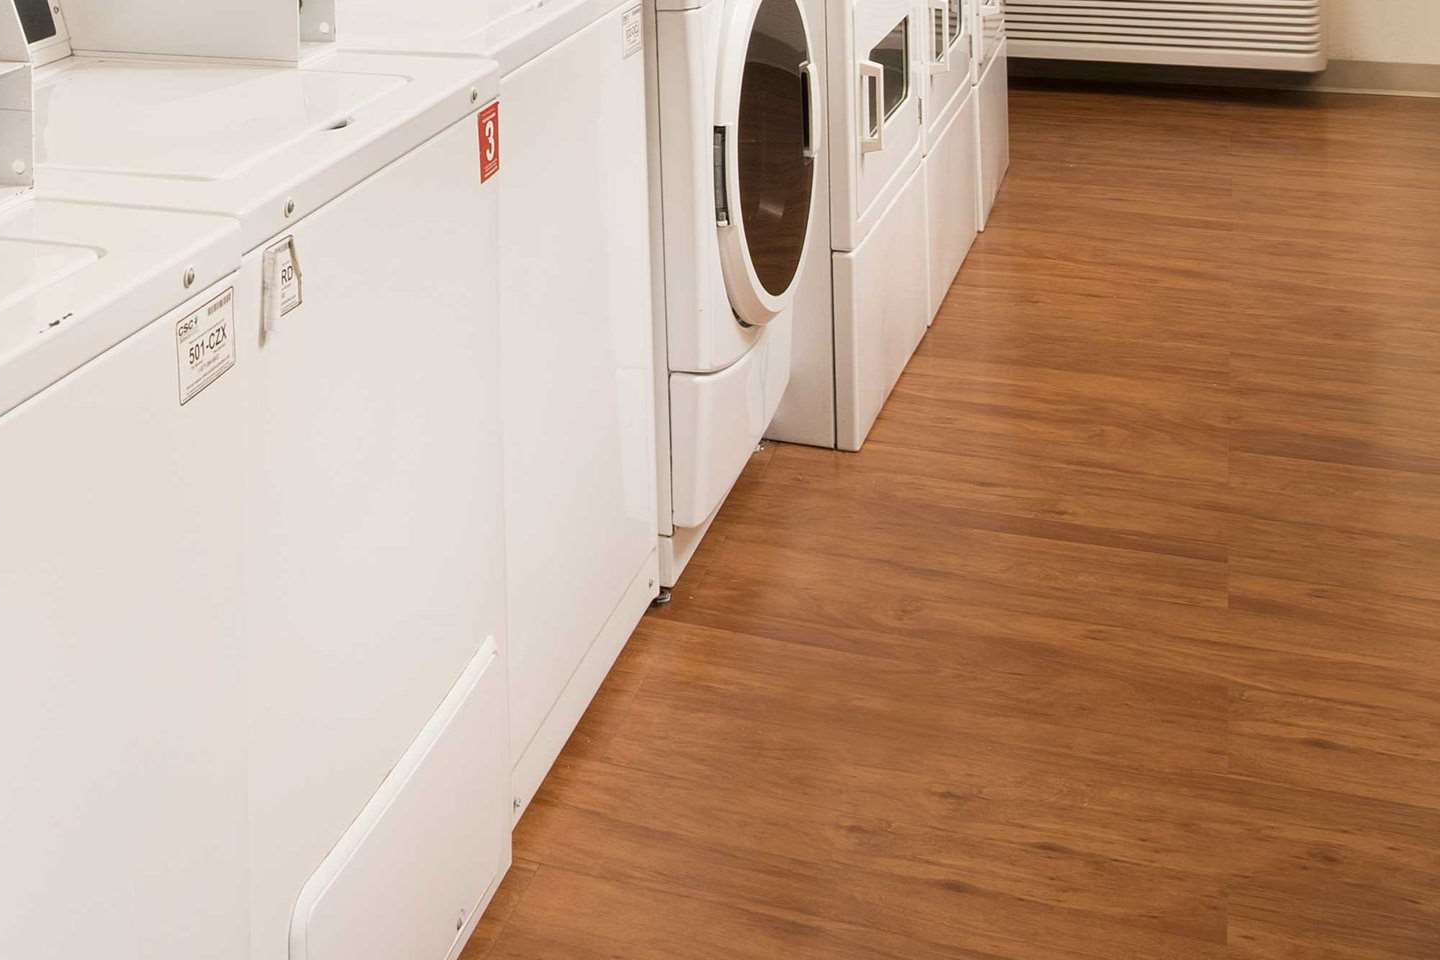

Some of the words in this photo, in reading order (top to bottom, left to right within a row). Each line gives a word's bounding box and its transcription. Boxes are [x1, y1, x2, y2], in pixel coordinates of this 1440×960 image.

[485, 120, 495, 161] 3
[178, 319, 194, 336] CSC
[189, 323, 227, 365] 501-CZX
